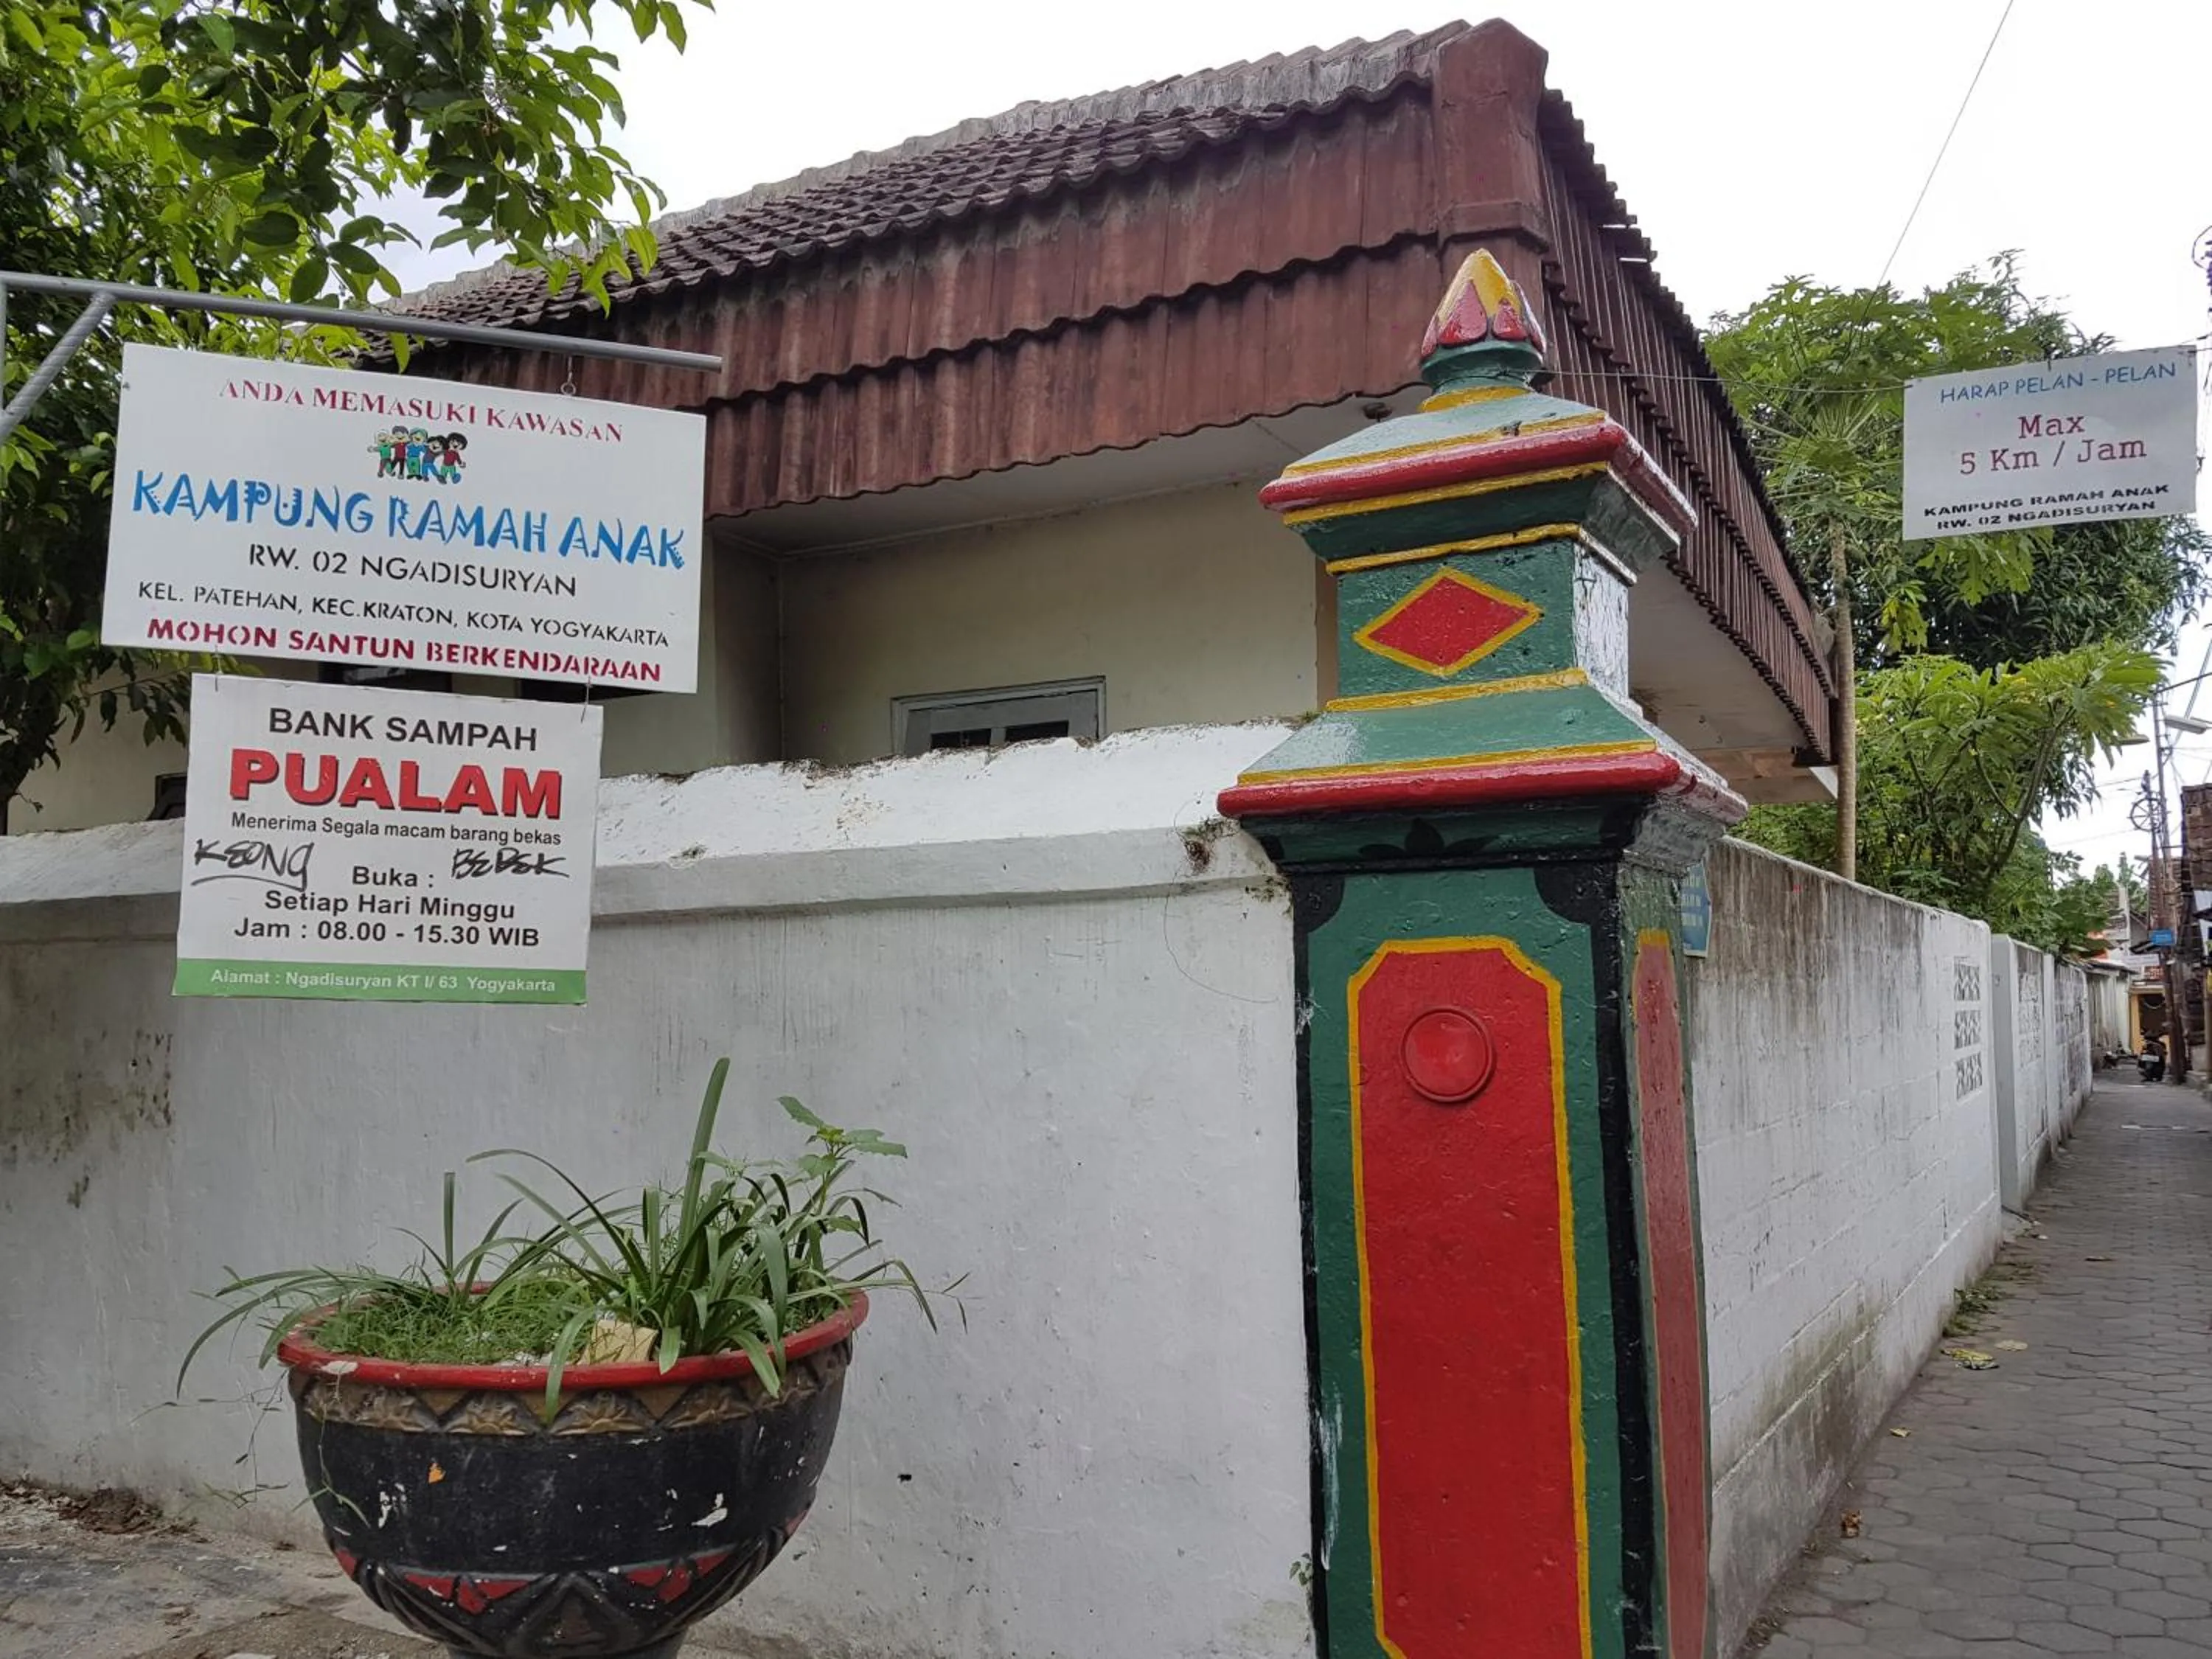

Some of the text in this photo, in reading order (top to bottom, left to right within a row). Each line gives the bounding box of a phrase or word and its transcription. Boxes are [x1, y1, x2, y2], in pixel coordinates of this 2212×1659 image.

[1940, 381, 2008, 403] HARAP
[2016, 372, 2083, 395] PELAN
[2106, 363, 2176, 383] PELAN
[220, 378, 624, 443] ANDA MEMASUKI KAWASAN
[2018, 414, 2085, 439] Max
[1960, 439, 2147, 475] 5 Km / Jam
[1924, 484, 2169, 517] KAMPUNG RAMAH ANAK
[1938, 501, 2155, 529] RW. 02 NGADISURYAN
[133, 469, 684, 571] KAMPUNG RAMAH ANAK
[249, 544, 577, 597] RW. 02 NGADISURYAN
[139, 581, 183, 602] KEL.
[194, 587, 302, 613] PATEHAN,
[467, 609, 523, 633] KOTA
[531, 617, 668, 647] YOGYAKARTA
[148, 619, 661, 682] MOHON SANTUN BERKENDARAAN
[269, 708, 537, 751] BANK SAMPAH
[230, 748, 561, 819] PUALAM
[232, 813, 560, 846] Menerima Segala macam barang bekas
[352, 866, 418, 888] Buka
[265, 891, 515, 922] Setiap Hari Minggu
[234, 918, 290, 939] Jam
[318, 922, 386, 941] 08.00
[414, 925, 479, 945] 15.30
[490, 926, 539, 947] WIB
[210, 970, 269, 984] Alamat
[285, 972, 391, 990] Ngadisuryan
[396, 975, 420, 987] KT
[467, 977, 555, 992] Yogyakarta
